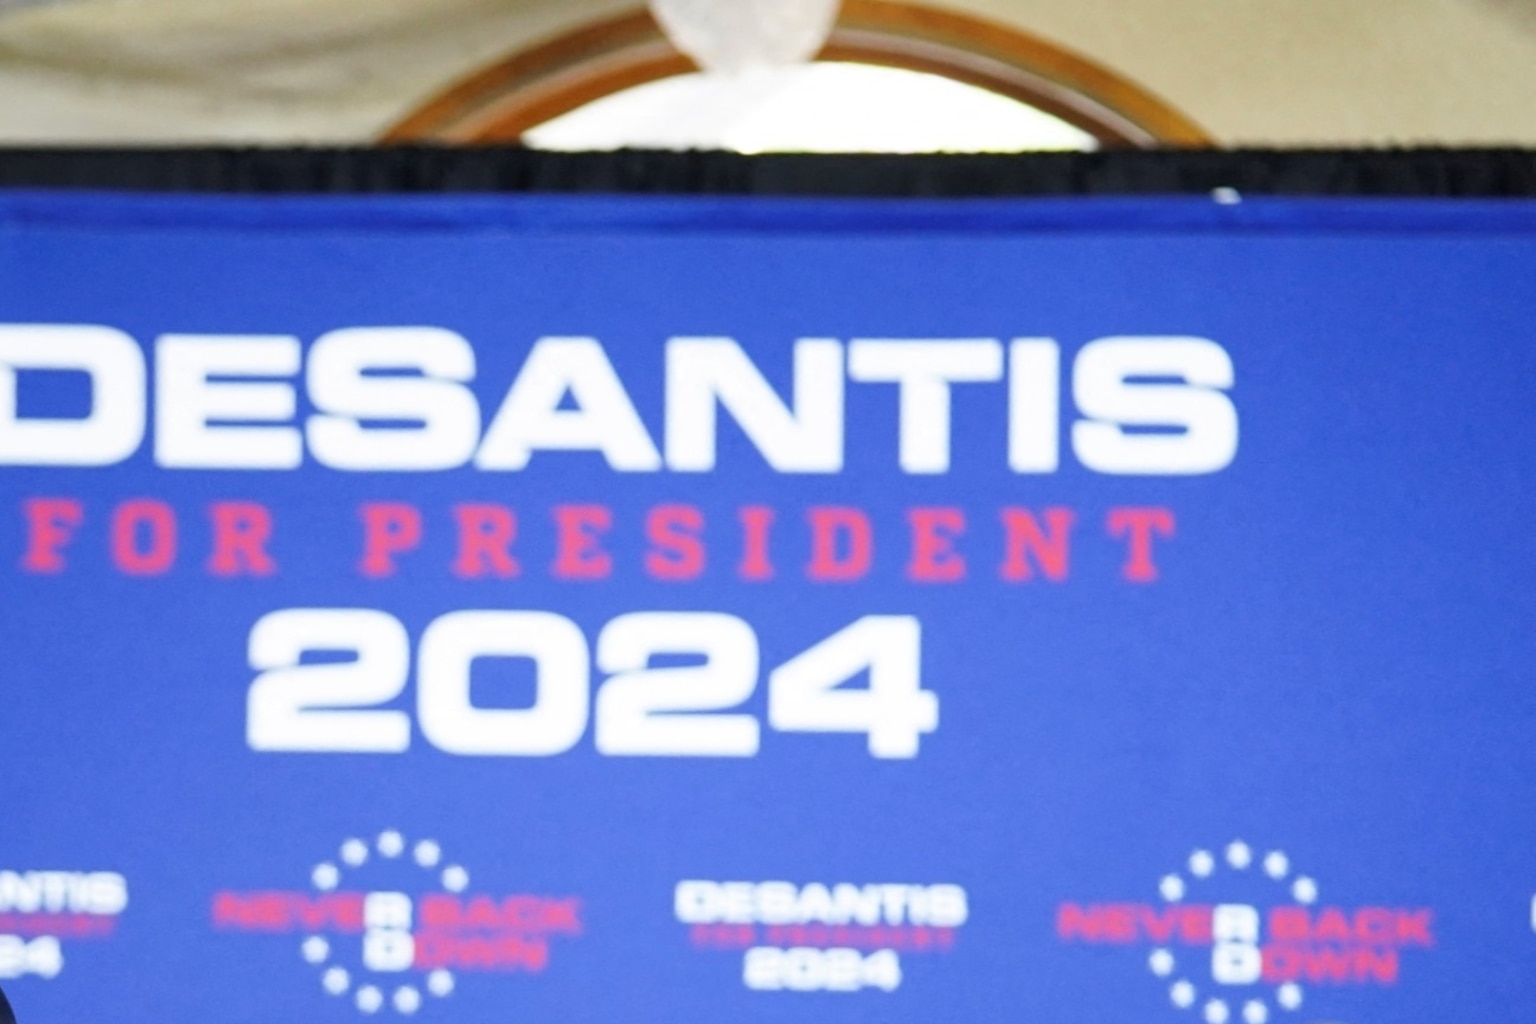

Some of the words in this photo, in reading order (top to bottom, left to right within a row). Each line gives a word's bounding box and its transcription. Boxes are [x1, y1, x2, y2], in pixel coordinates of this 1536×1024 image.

[20, 498, 276, 576] FOR
[359, 504, 1175, 583] PRESIDENT
[246, 608, 939, 760] 2024
[674, 880, 968, 927] DESANTIS
[1057, 903, 1260, 943] NEVER
[1270, 907, 1432, 947] BACK
[743, 946, 902, 992] 2024
[1211, 943, 1399, 984] DOWN
